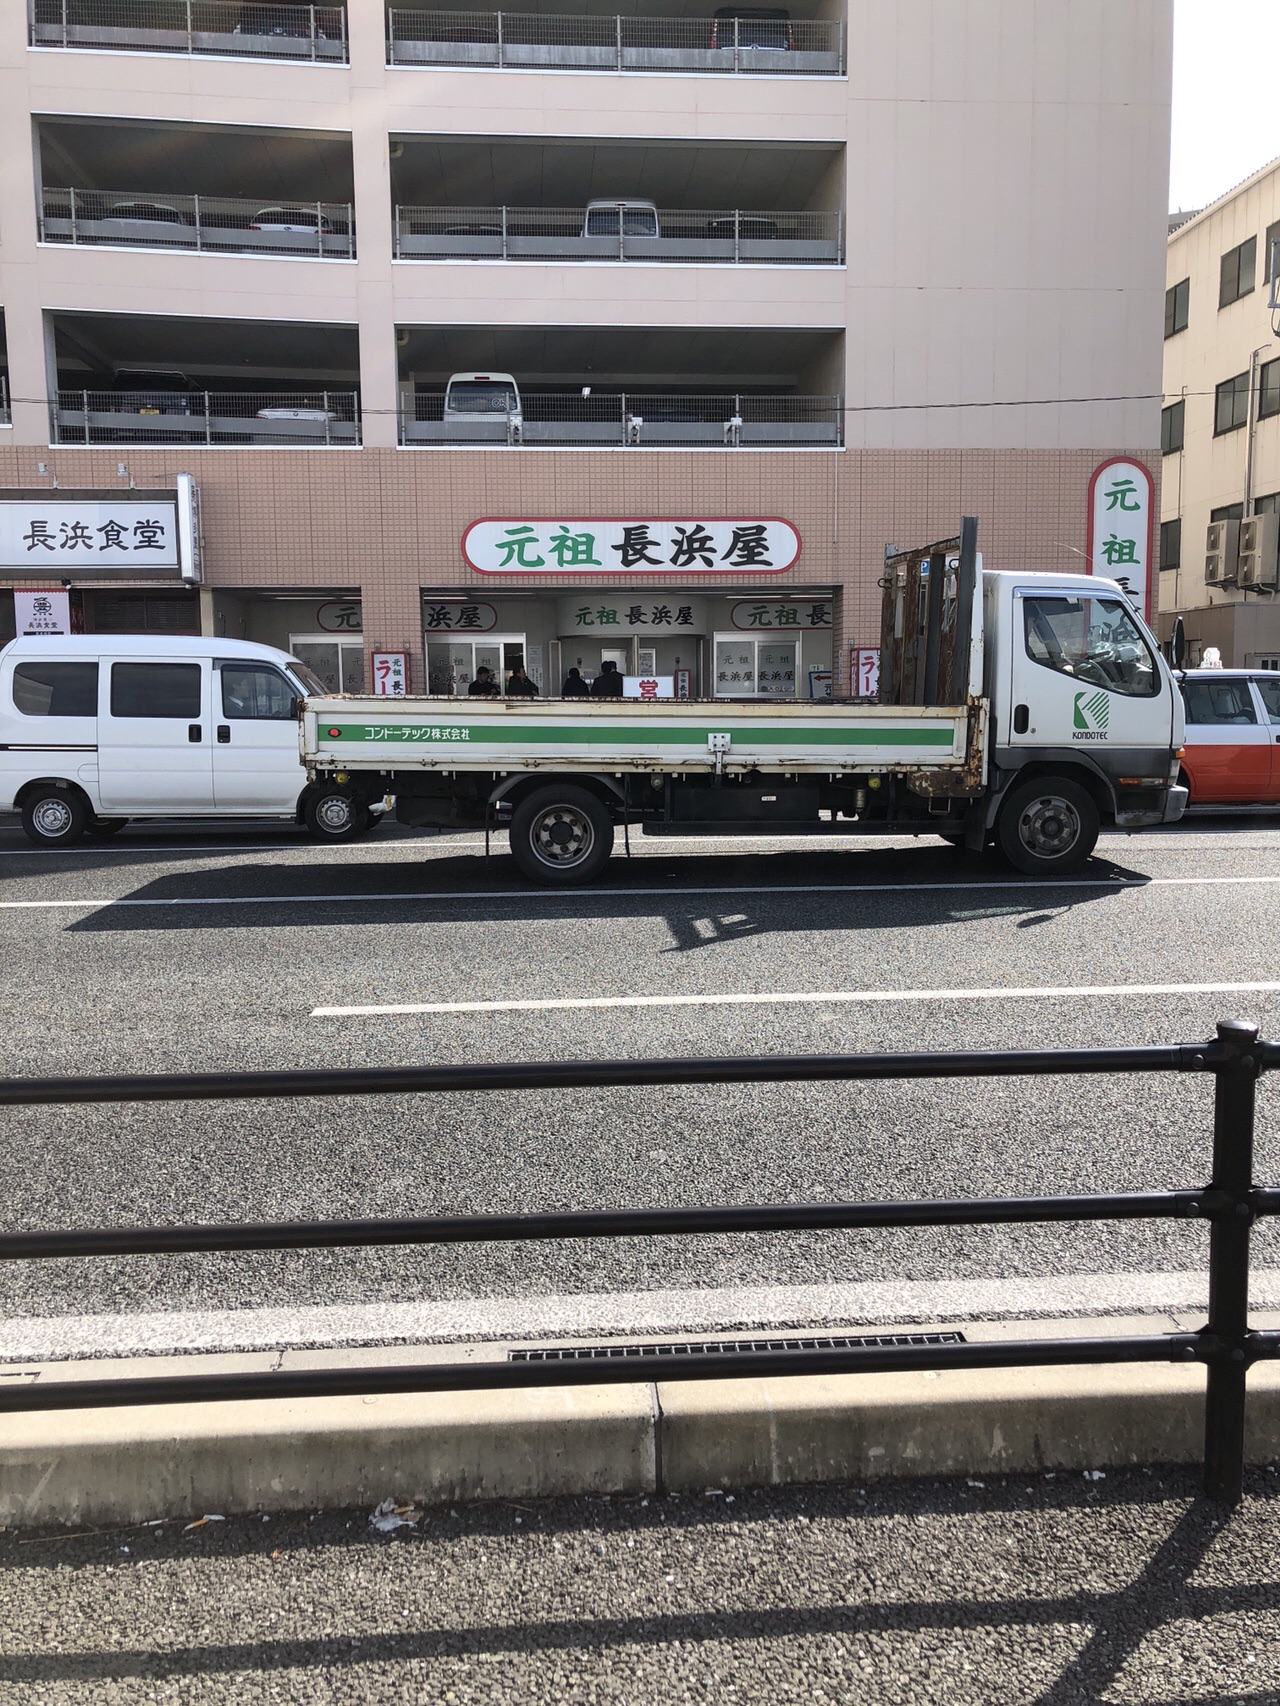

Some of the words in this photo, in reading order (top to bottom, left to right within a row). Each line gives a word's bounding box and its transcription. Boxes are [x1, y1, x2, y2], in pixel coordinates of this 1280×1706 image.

[23, 519, 166, 551] 長浜食堂
[495, 524, 774, 568] 元祖長浜屋
[427, 606, 483, 628] 浜屋
[575, 605, 694, 626] 元祖長浜屋
[364, 727, 470, 740] コンドーテック株式会社
[1072, 731, 1108, 740] KONDOTEC
